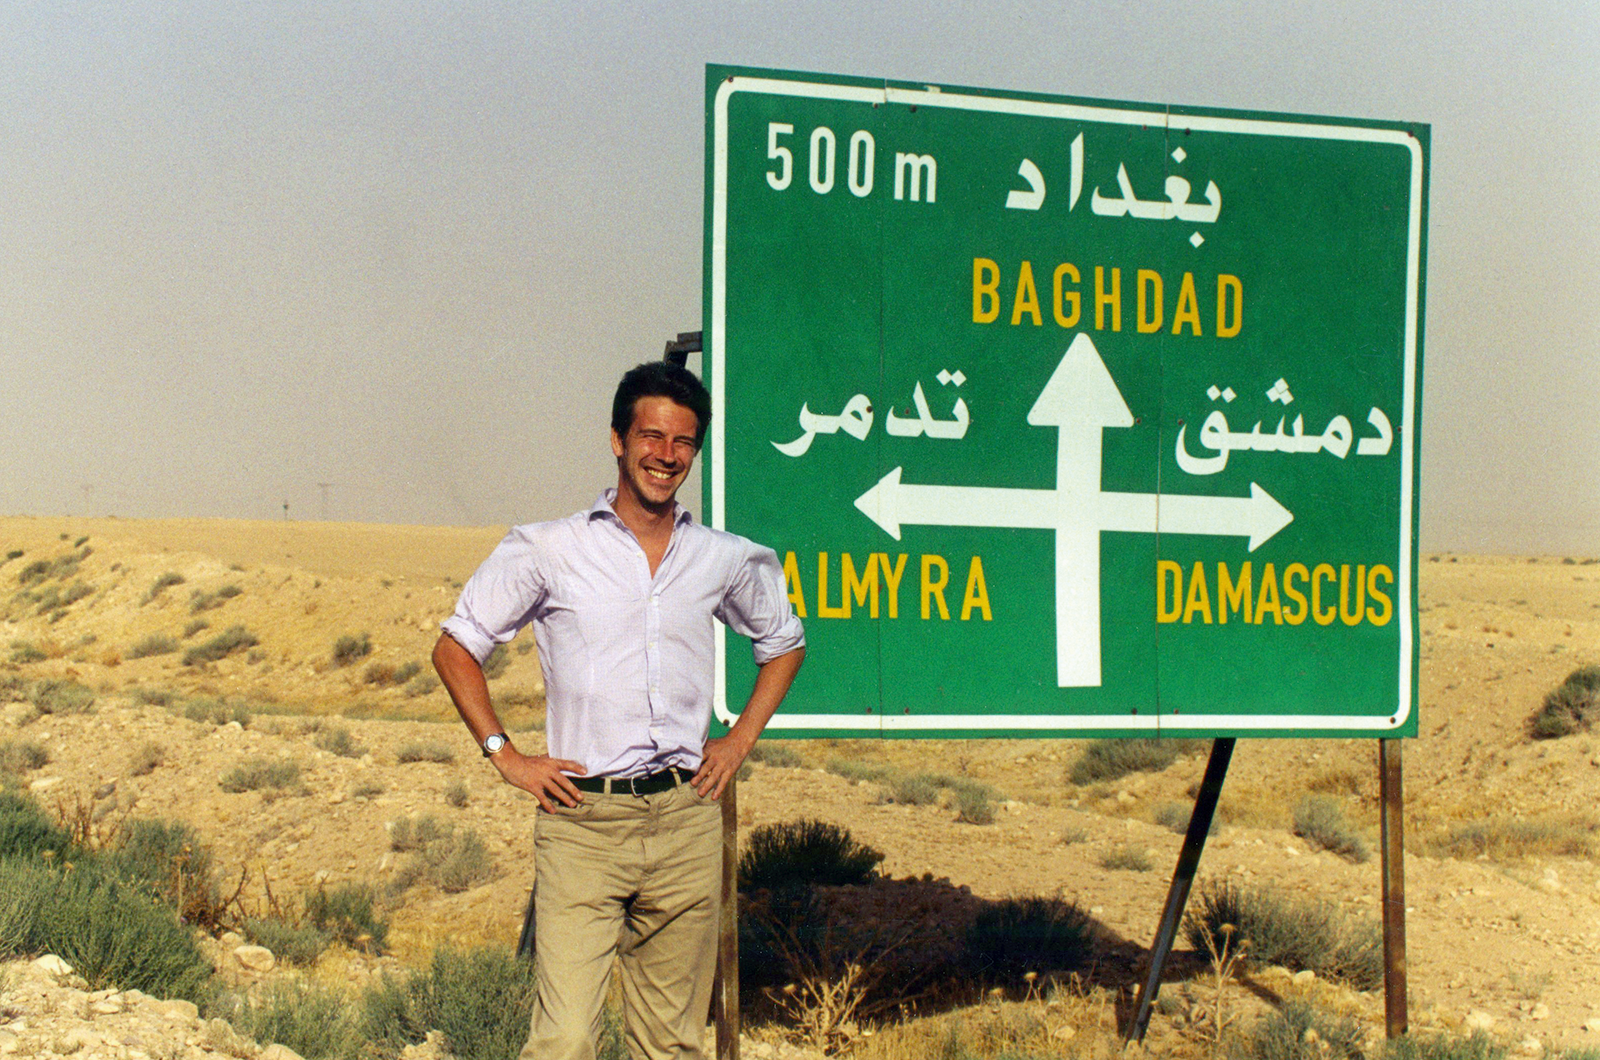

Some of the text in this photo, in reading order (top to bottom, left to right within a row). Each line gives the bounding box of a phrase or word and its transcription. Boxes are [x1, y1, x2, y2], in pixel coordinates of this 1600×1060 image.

[766, 122, 937, 204] 500 m
[1005, 132, 1222, 248] بغداد
[971, 257, 1243, 338] BAGHDAD
[770, 369, 970, 457] تدمر
[1174, 378, 1394, 476] دمشق
[783, 551, 993, 621] ALMYRA
[1156, 560, 1394, 627] DAMASCUS
